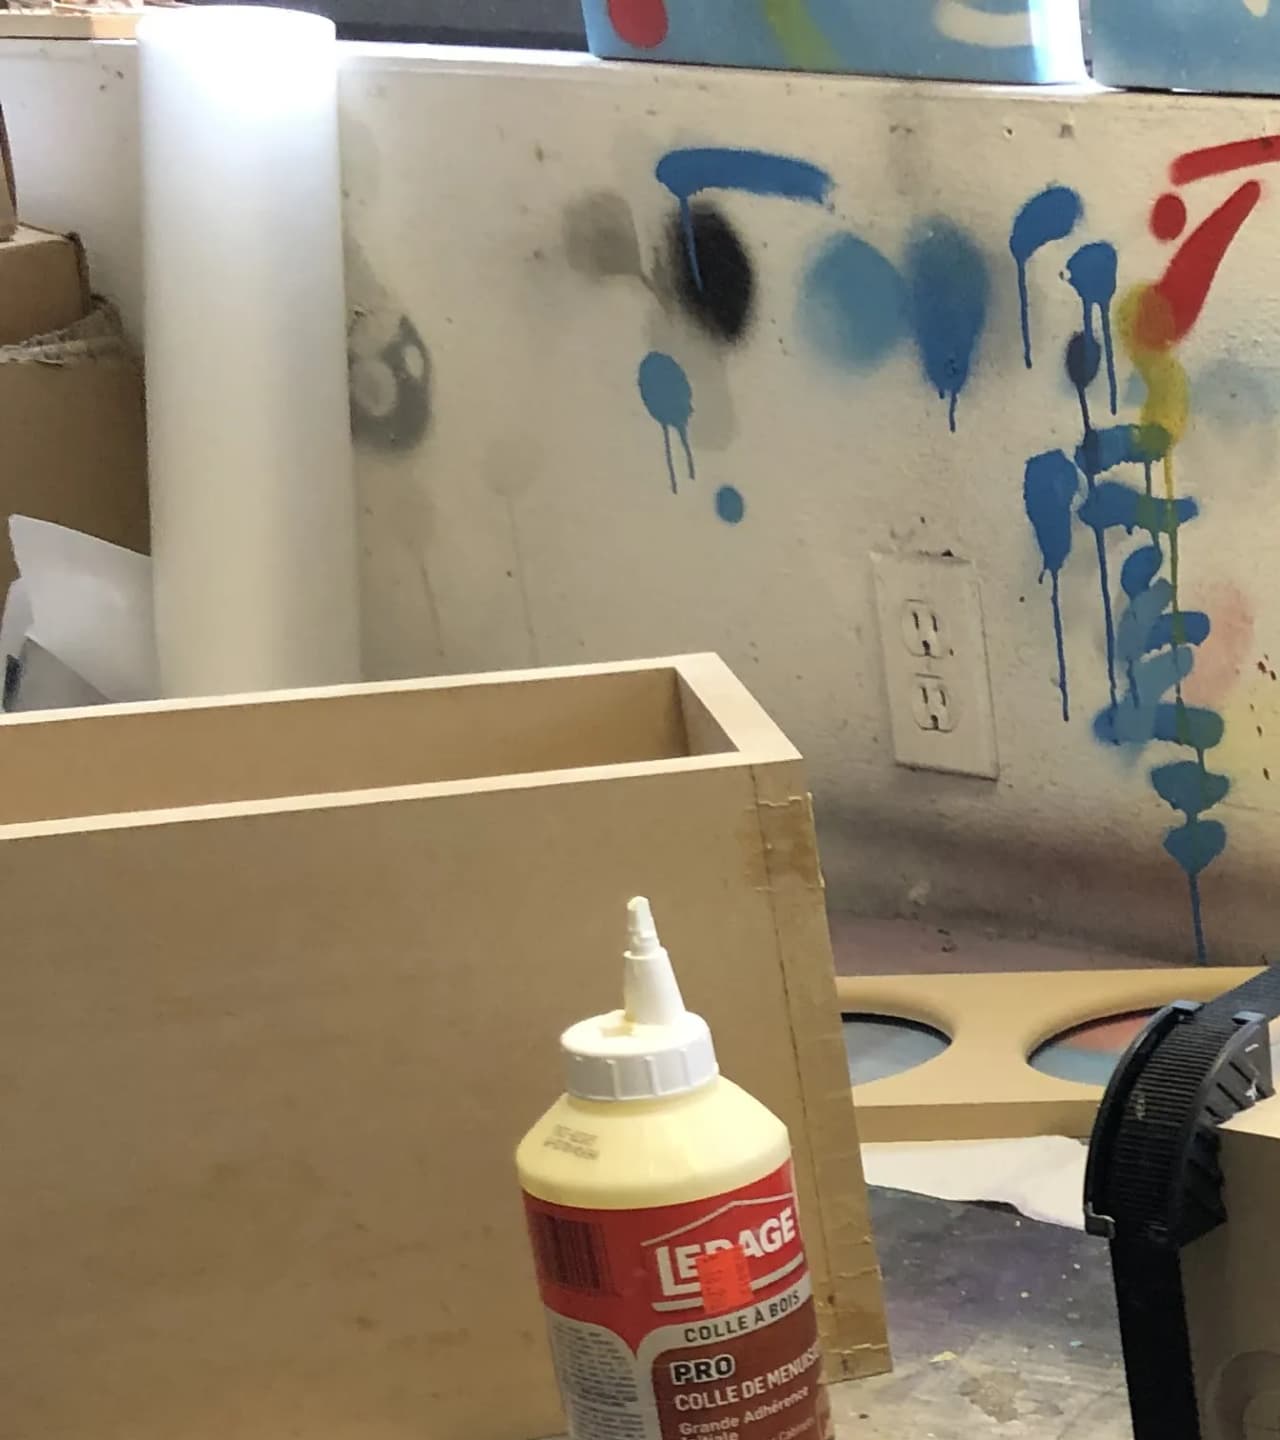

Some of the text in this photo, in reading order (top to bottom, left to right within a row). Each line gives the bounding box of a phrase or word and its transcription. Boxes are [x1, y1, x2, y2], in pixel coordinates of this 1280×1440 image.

[684, 1290, 800, 1343] COLLE À BOIS
[670, 1354, 736, 1385] PRO
[675, 1386, 740, 1412] COLLE
[742, 1376, 768, 1400] DE
[679, 1416, 739, 1436] Grande
